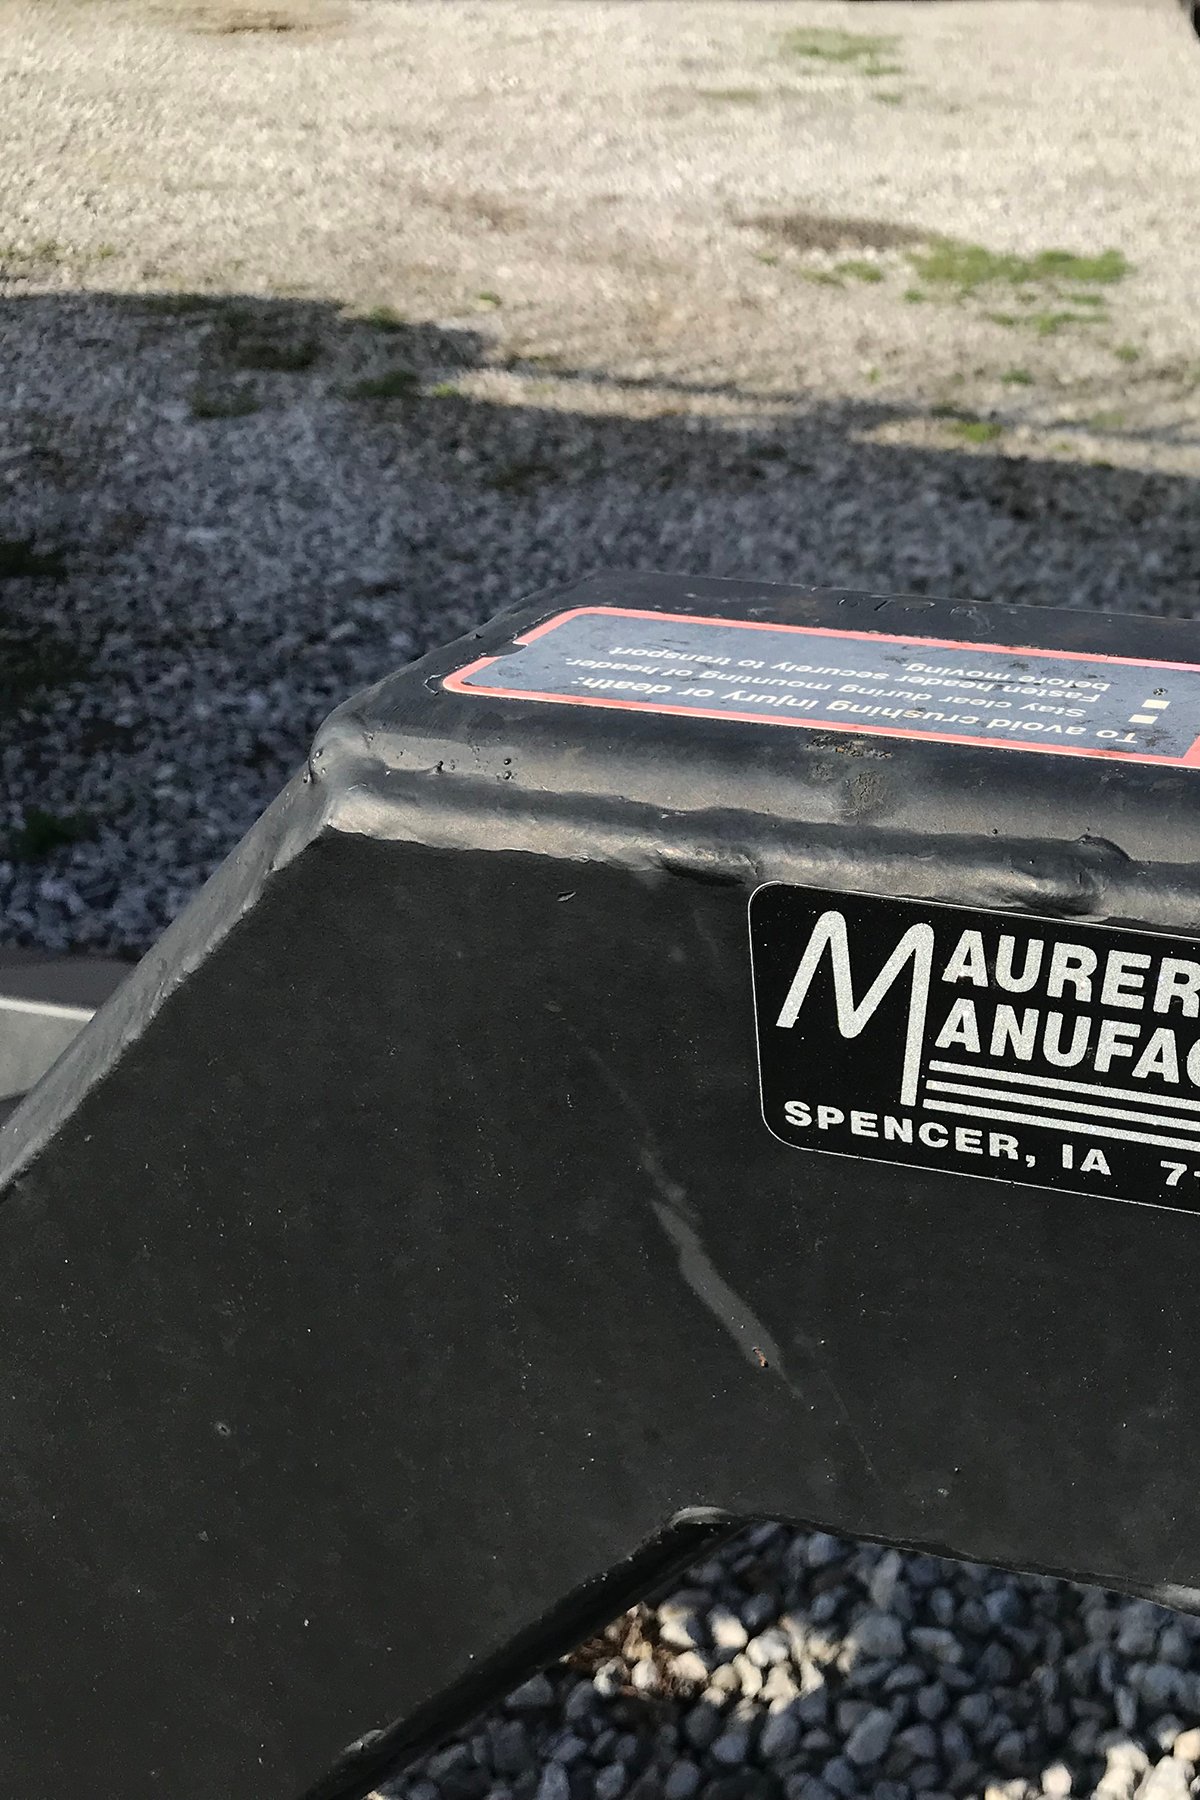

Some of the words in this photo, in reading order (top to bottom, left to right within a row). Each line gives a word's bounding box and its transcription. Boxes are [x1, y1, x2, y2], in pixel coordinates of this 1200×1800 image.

[608, 645, 731, 667] transport
[738, 658, 765, 671] to
[564, 657, 658, 678] header.
[661, 667, 695, 680] of
[769, 661, 891, 683] securely
[899, 662, 1011, 684] moving.
[571, 675, 673, 695] death:
[699, 669, 832, 693] mounting
[893, 673, 996, 694] header
[1017, 674, 1111, 693] before
[675, 686, 716, 701] or
[722, 690, 819, 711] injury
[836, 682, 932, 707] during
[944, 693, 1014, 713] clear
[999, 685, 1101, 705] Fasten
[826, 699, 980, 723] crushing
[1019, 701, 1087, 719] Stay
[986, 714, 1086, 735] avoid
[1096, 728, 1139, 744] To
[784, 1100, 1036, 1169] SPENCER,
[1062, 1143, 1112, 1177] IA
